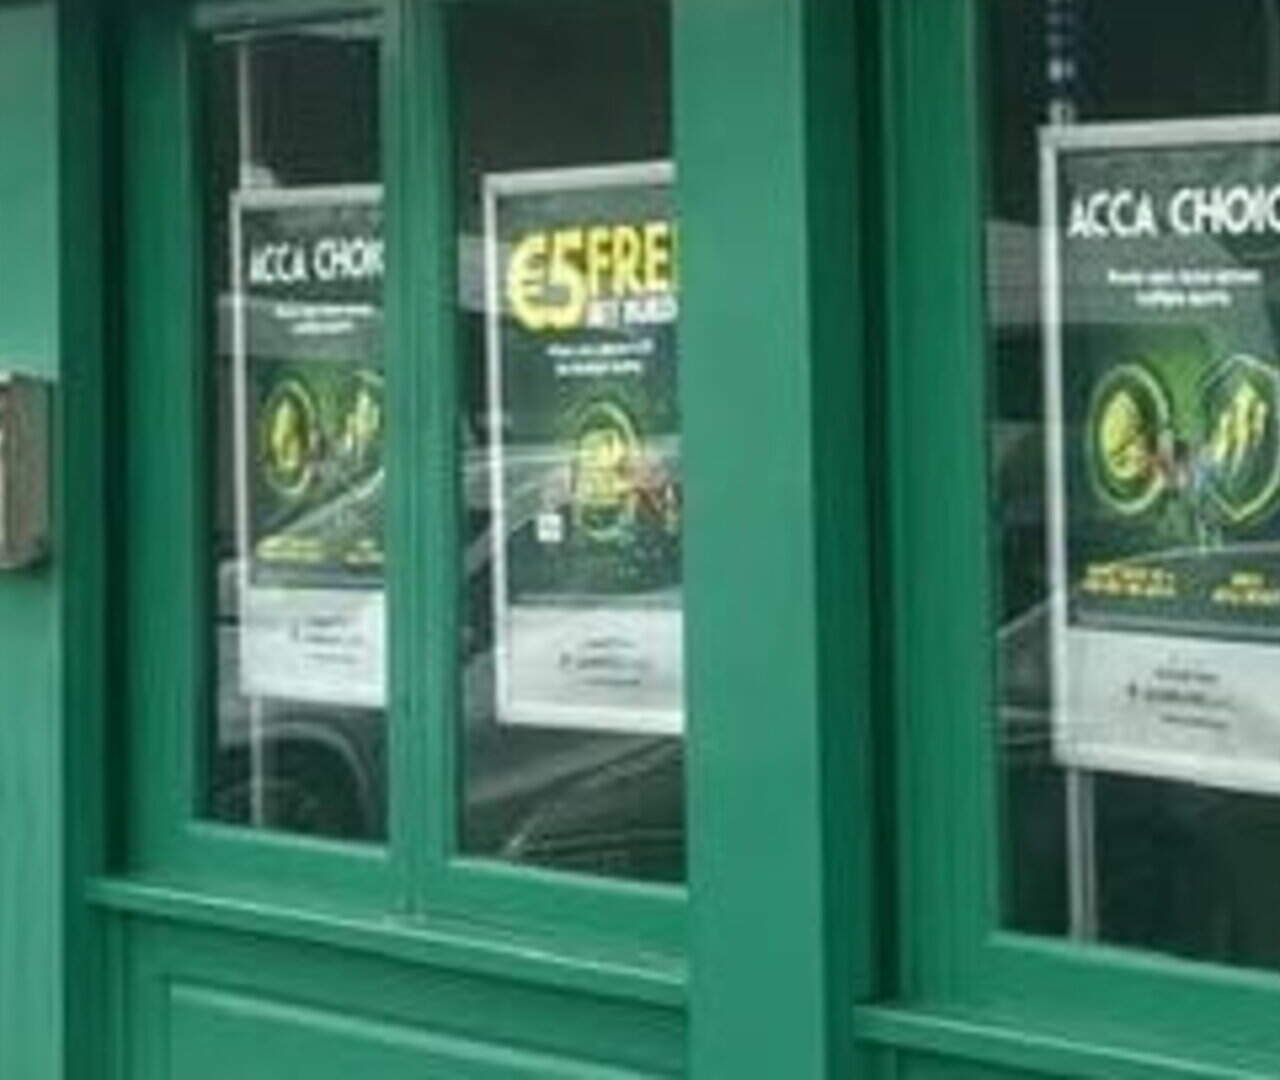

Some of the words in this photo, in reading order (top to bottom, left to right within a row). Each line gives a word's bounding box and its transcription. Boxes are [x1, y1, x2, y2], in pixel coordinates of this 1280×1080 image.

[1067, 188, 1159, 238] ACCA
[249, 241, 308, 285] ACCA
[587, 220, 679, 296] FRE
